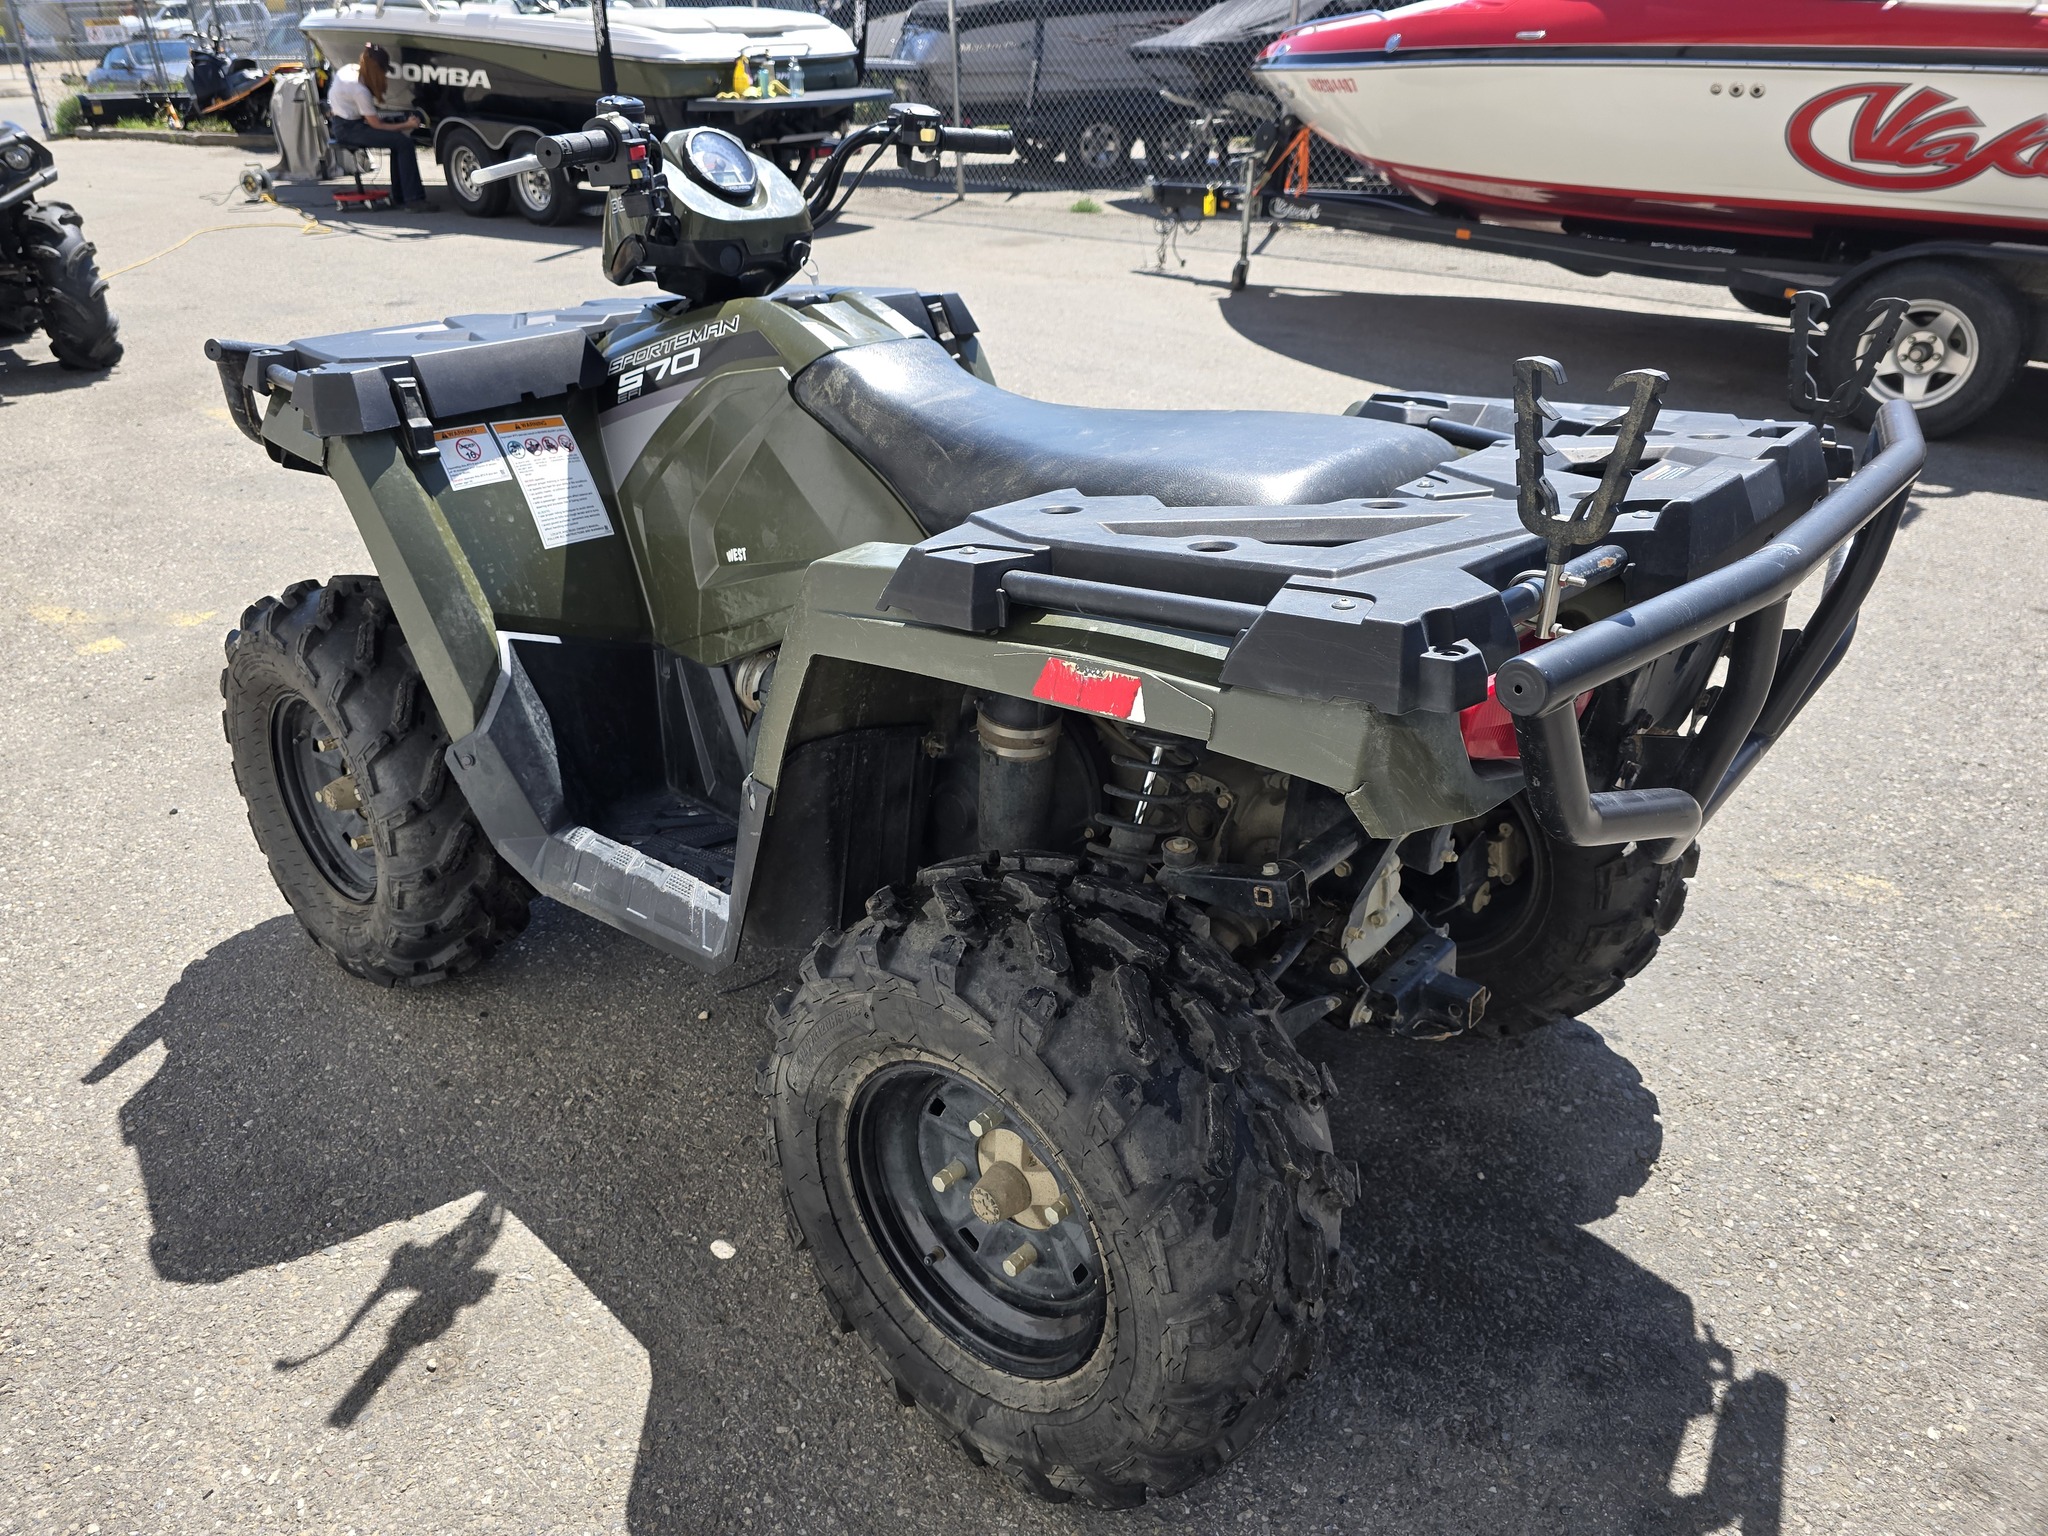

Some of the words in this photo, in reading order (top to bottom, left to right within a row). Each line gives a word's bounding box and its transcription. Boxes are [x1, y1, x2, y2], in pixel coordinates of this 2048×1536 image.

[386, 61, 492, 90] OOMBA
[607, 315, 740, 376] SPORTSMAN
[617, 347, 701, 395] 570
[617, 386, 642, 404] EFI
[449, 428, 478, 438] WARNING
[521, 420, 547, 428] WARNING
[726, 547, 747, 563] WEST
